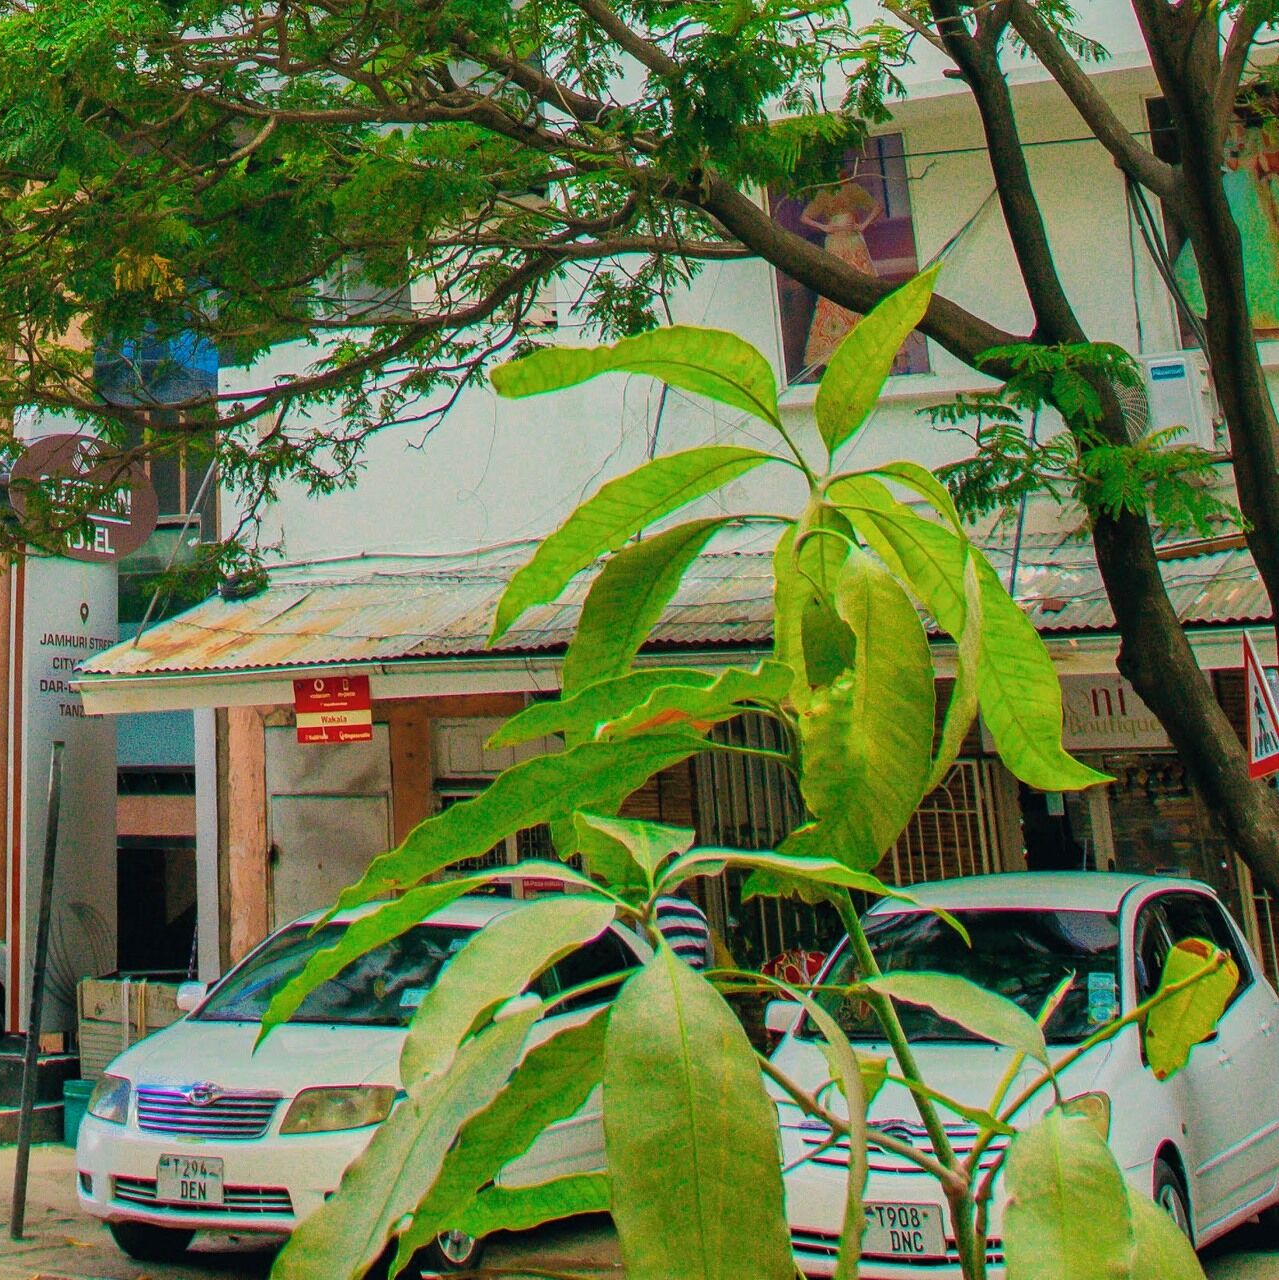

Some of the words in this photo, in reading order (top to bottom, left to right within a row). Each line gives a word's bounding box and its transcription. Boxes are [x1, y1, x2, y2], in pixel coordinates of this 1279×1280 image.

[40, 633, 87, 649] JAMHURI
[52, 657, 76, 670] CITY
[321, 715, 347, 724] Wakala
[180, 1180, 207, 1200] DEN
[875, 1206, 920, 1228] T908
[890, 1230, 924, 1253] DNC
